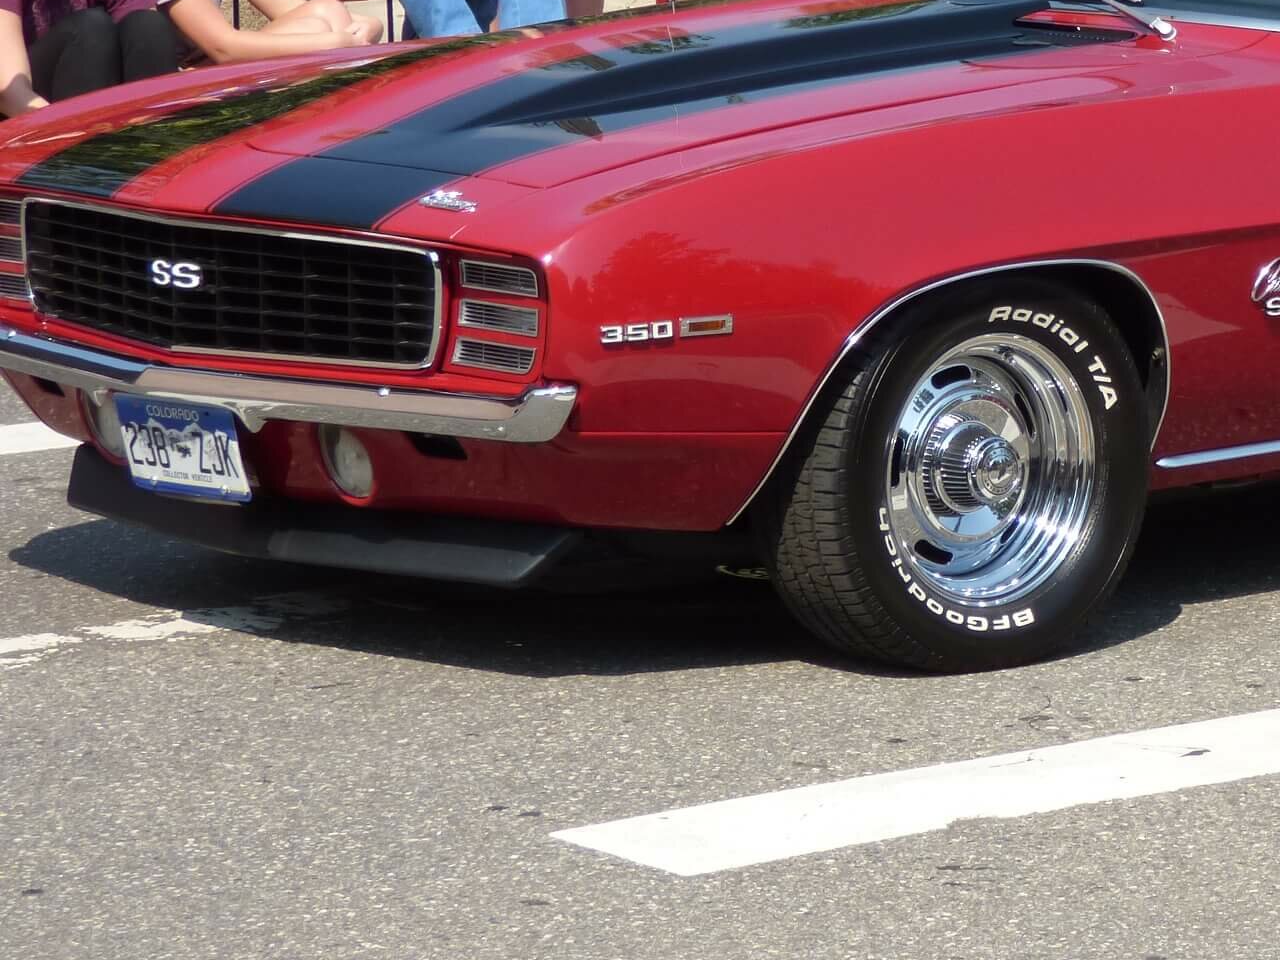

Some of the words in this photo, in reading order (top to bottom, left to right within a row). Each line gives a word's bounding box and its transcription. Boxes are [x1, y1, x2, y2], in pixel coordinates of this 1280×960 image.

[151, 259, 201, 289] SS
[600, 321, 673, 344] 350
[988, 305, 1089, 354] Radial
[1087, 355, 1118, 410] T/A
[145, 404, 200, 422] COLORADO
[878, 506, 1036, 632] BFGoodrich
